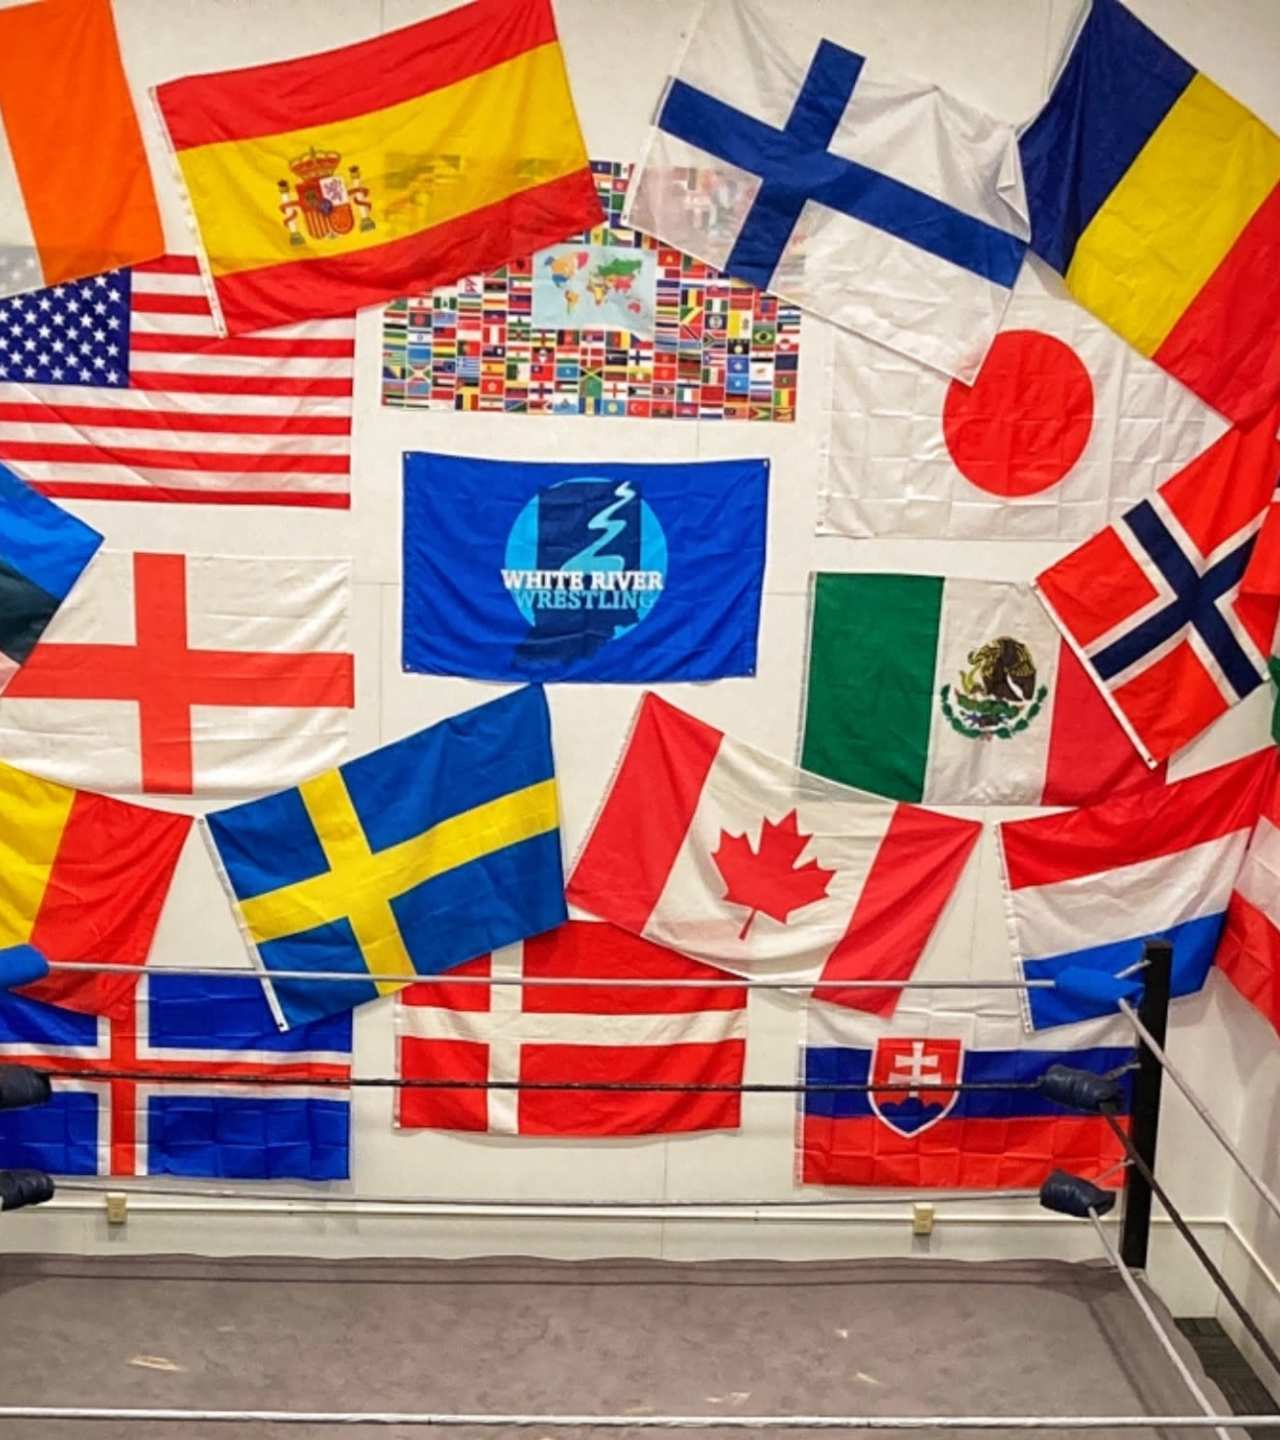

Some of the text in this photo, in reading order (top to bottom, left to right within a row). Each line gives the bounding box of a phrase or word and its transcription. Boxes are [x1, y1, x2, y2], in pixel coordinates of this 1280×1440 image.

[501, 569, 664, 591] WHITE RIVER
[514, 589, 654, 610] WRESTLING
